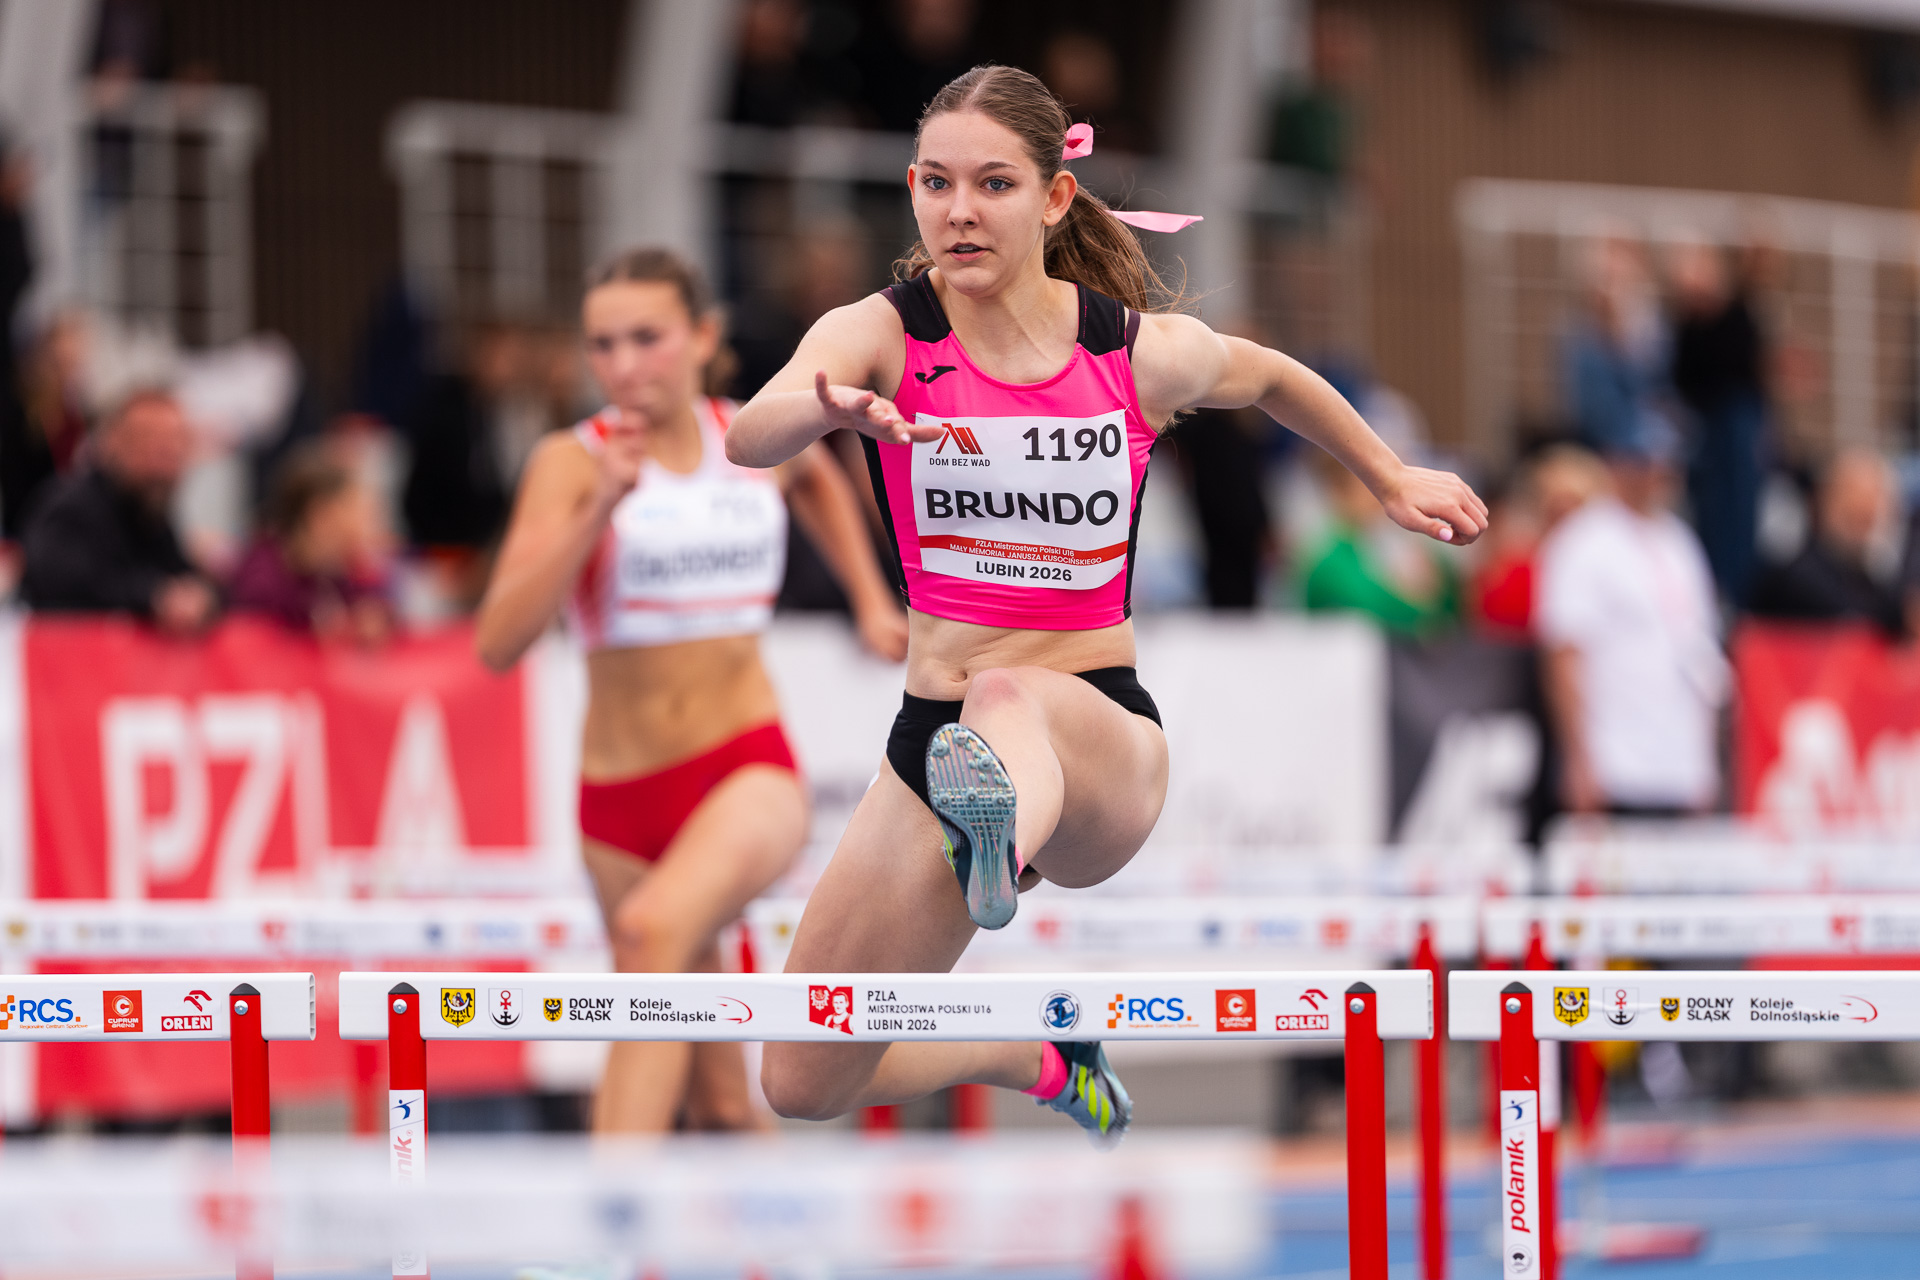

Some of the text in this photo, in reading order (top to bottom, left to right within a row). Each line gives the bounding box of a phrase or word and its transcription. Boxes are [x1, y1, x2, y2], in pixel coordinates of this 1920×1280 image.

[1022, 423, 1122, 462] 1190
[929, 457, 991, 467] DOM BEZ WAD
[925, 488, 1119, 526] BRUNDO
[975, 539, 992, 549] PZLA
[993, 542, 1038, 554] Mistrzostwa
[1039, 546, 1061, 555] Polski
[950, 543, 1102, 566] MAŁY MEMORIAŁ JANUSZA KUSOCIŃSKIEGO
[976, 561, 1072, 582] LUBIN 2026
[867, 990, 897, 1001] PZLA
[569, 998, 614, 1009] DOLNY
[630, 999, 672, 1011] Koleje
[868, 1004, 992, 1014] MISTRZOSTWA POLSKI U16
[1687, 998, 1734, 1010] DOLNY
[1750, 998, 1794, 1011] Koleje
[569, 1008, 612, 1022] ŚLĄSK
[630, 1009, 716, 1023] Dolnośląskie
[1687, 1008, 1731, 1022] ŚLĄSK
[1750, 1009, 1840, 1023] Dolnośląskie
[162, 1016, 212, 1031] ORLEN
[867, 1019, 937, 1030] LUBIN 2026
[1277, 1015, 1327, 1030] ORLEN
[1506, 1137, 1531, 1233] polanik
